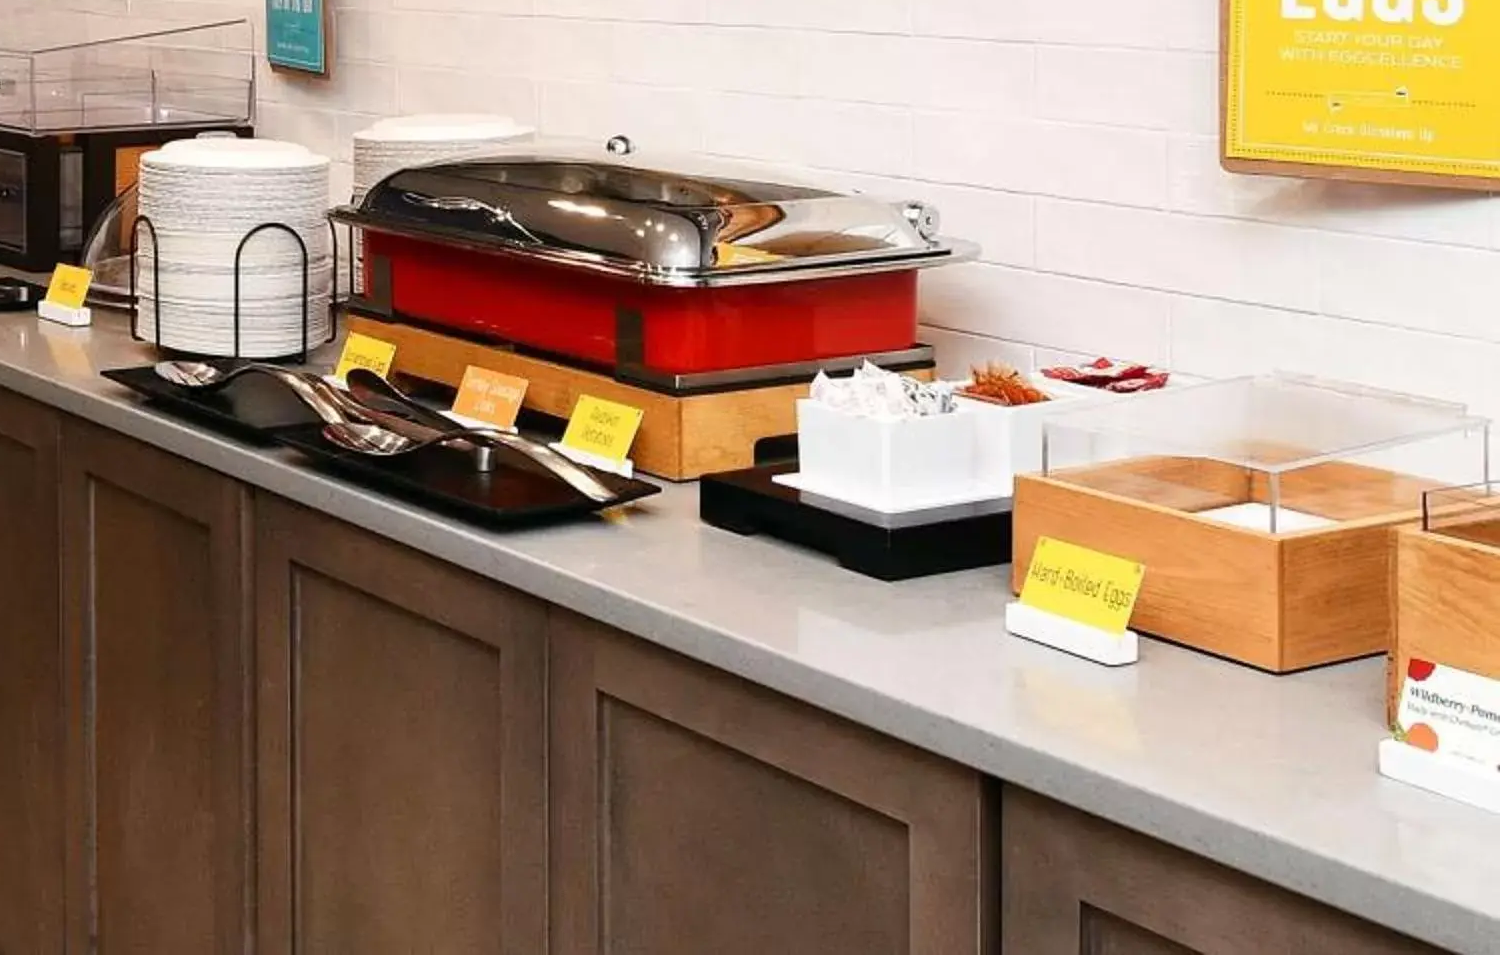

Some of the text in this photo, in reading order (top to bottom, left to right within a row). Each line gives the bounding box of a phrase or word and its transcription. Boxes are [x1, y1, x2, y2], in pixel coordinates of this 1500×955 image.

[1355, 33, 1403, 47] YOUR
[1408, 36, 1444, 50] DAY
[1279, 46, 1325, 61] WITH
[1102, 579, 1134, 612] Eggs
